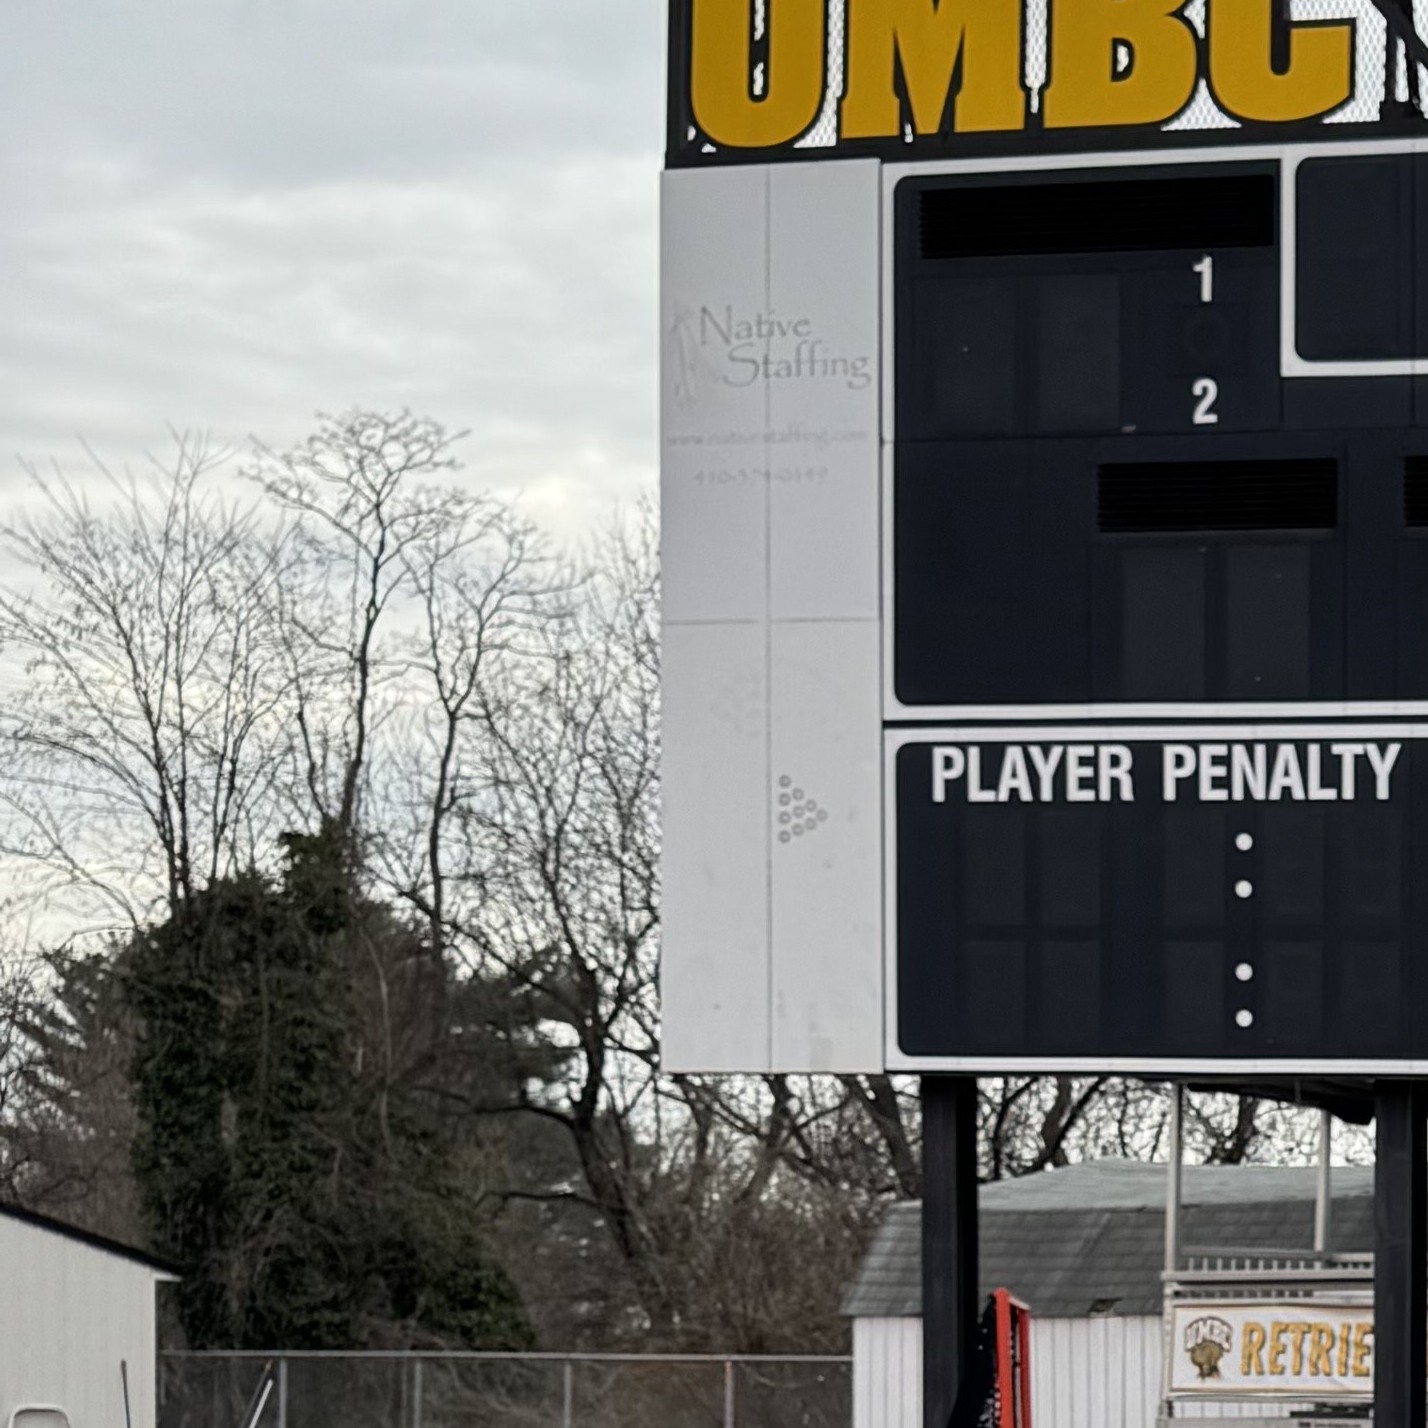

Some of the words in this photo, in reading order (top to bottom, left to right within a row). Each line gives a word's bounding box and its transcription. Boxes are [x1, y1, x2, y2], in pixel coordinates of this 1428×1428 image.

[689, 0, 1352, 148] UMBC
[1192, 254, 1213, 303] 1
[700, 304, 812, 346] Native
[721, 340, 872, 390] Staffing
[1192, 377, 1219, 426] 2
[931, 744, 1135, 802] PLAYER
[1161, 743, 1402, 801] PENALTY
